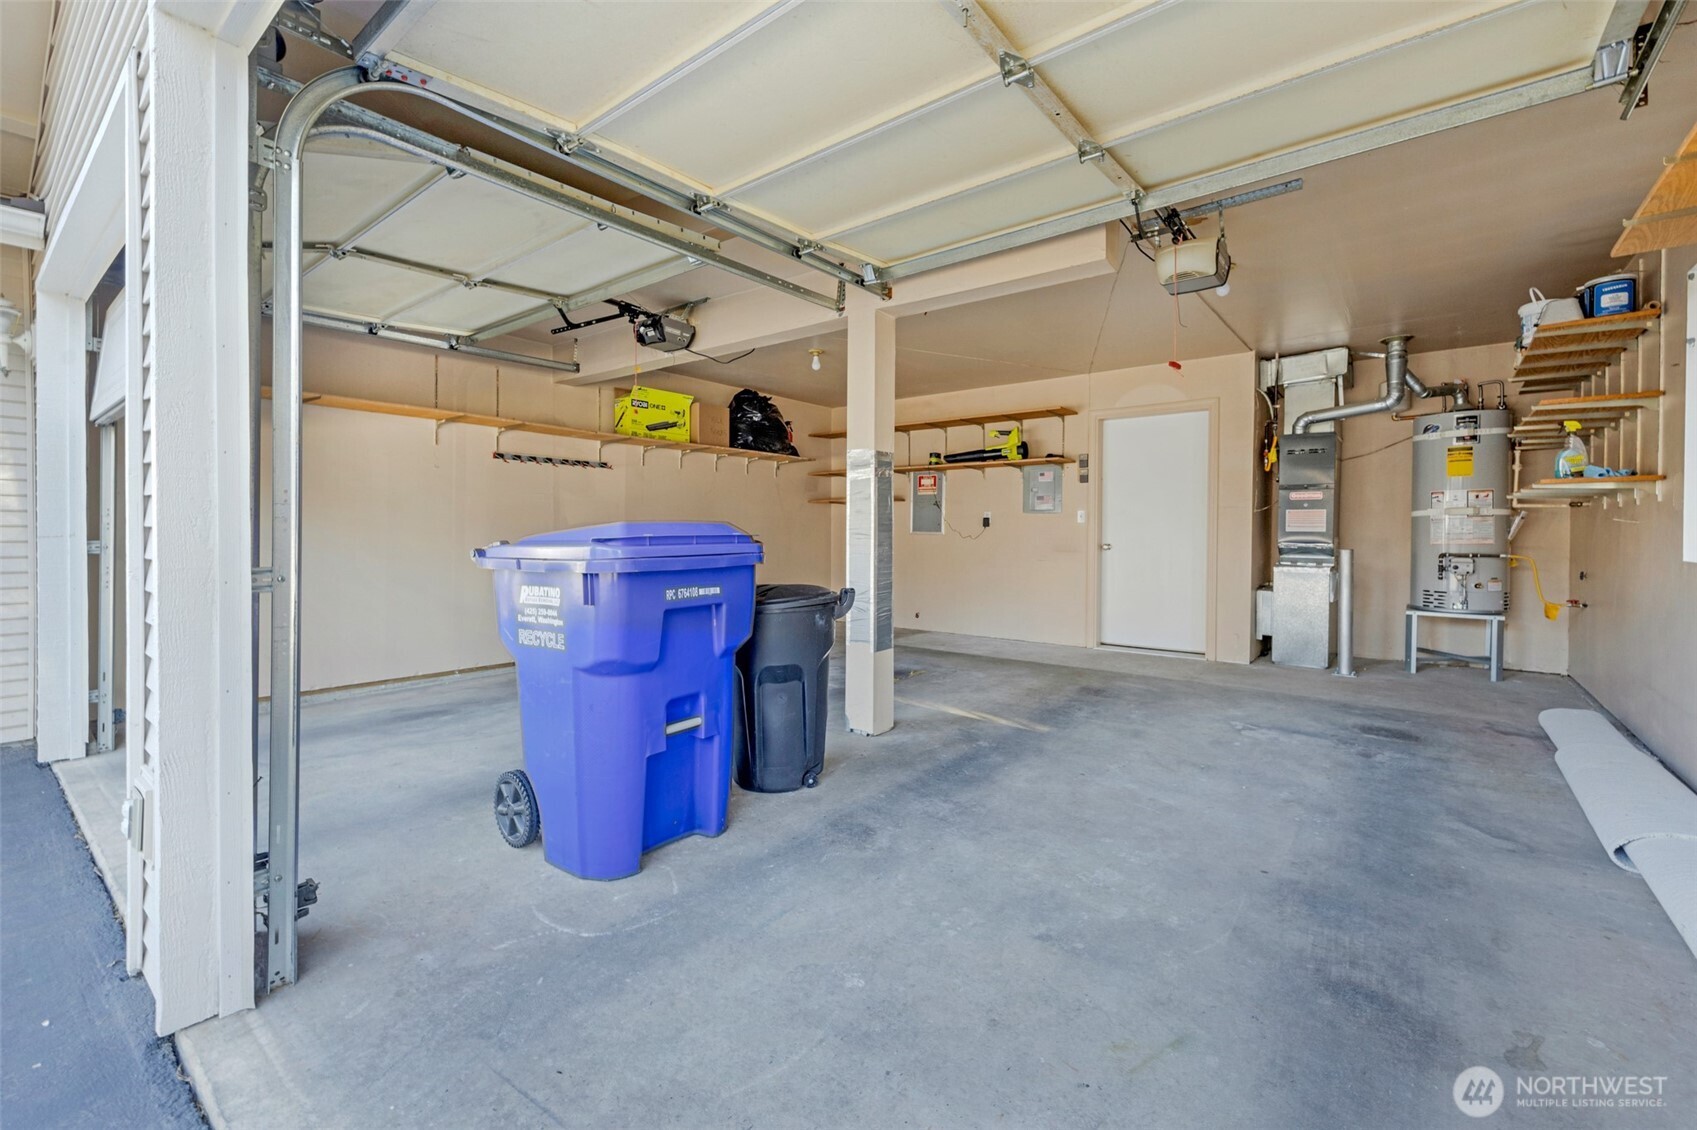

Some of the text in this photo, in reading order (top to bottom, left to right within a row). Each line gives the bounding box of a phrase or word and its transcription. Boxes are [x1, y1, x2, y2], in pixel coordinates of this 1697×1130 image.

[632, 400, 648, 408] RYOBI
[520, 585, 561, 603] RUBATINO
[666, 589, 676, 600] RPC
[518, 614, 564, 627] Everett, Washington
[518, 629, 565, 650] RECYCLE
